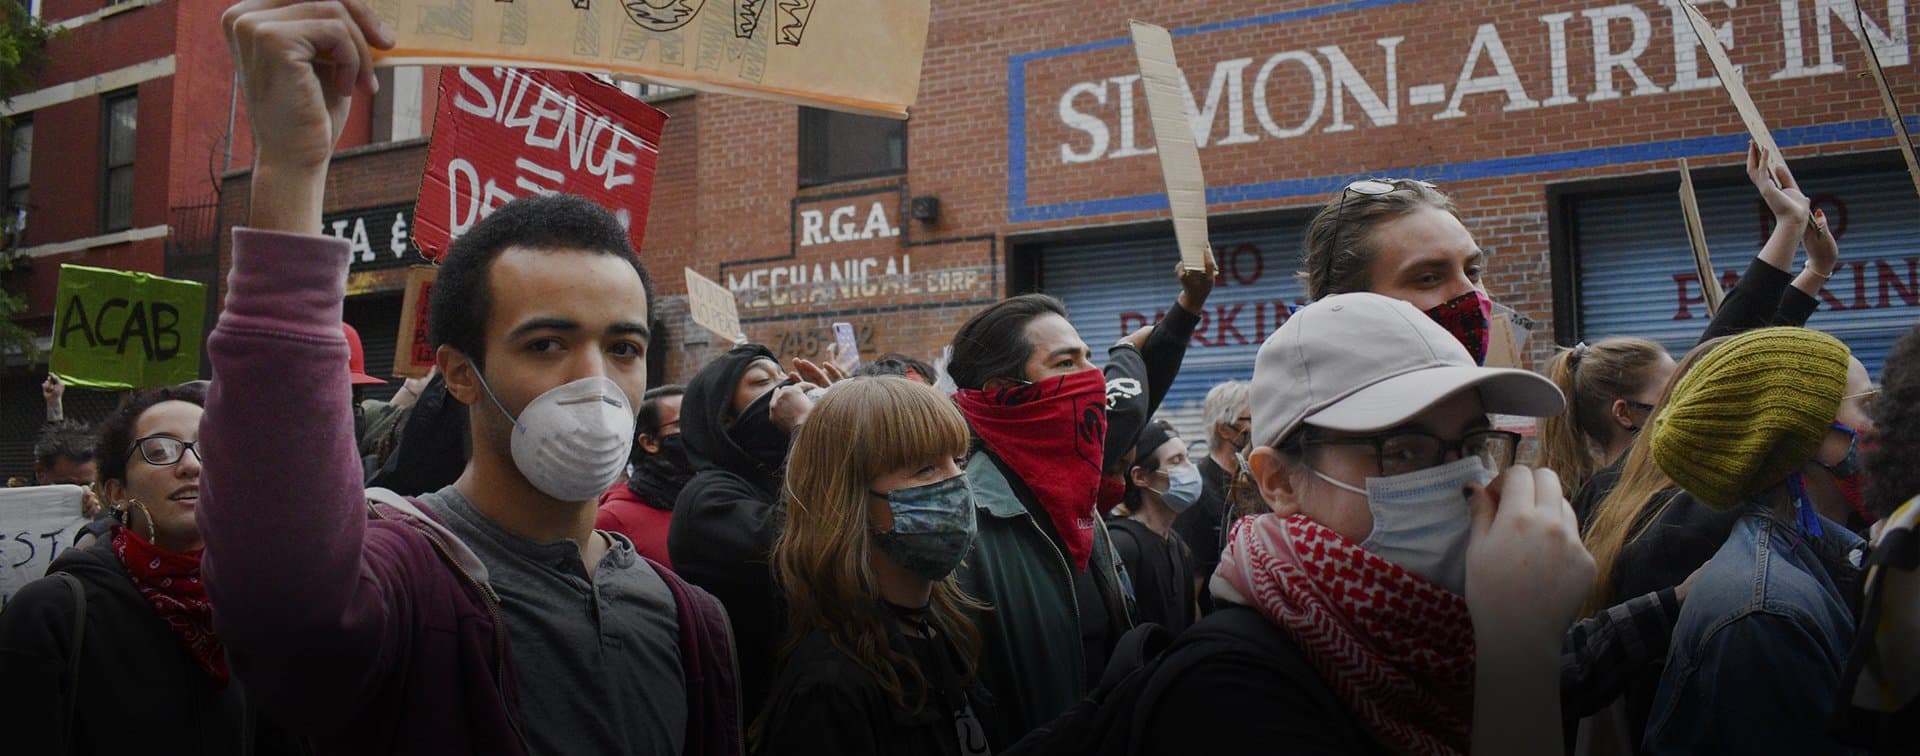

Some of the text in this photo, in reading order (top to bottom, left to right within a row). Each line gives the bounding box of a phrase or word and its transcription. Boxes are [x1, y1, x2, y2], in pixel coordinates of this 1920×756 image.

[453, 65, 638, 190] SILENCE
[799, 201, 900, 247] R.G.A.
[727, 254, 922, 309] MECHANICAL
[58, 293, 182, 363] ACAB
